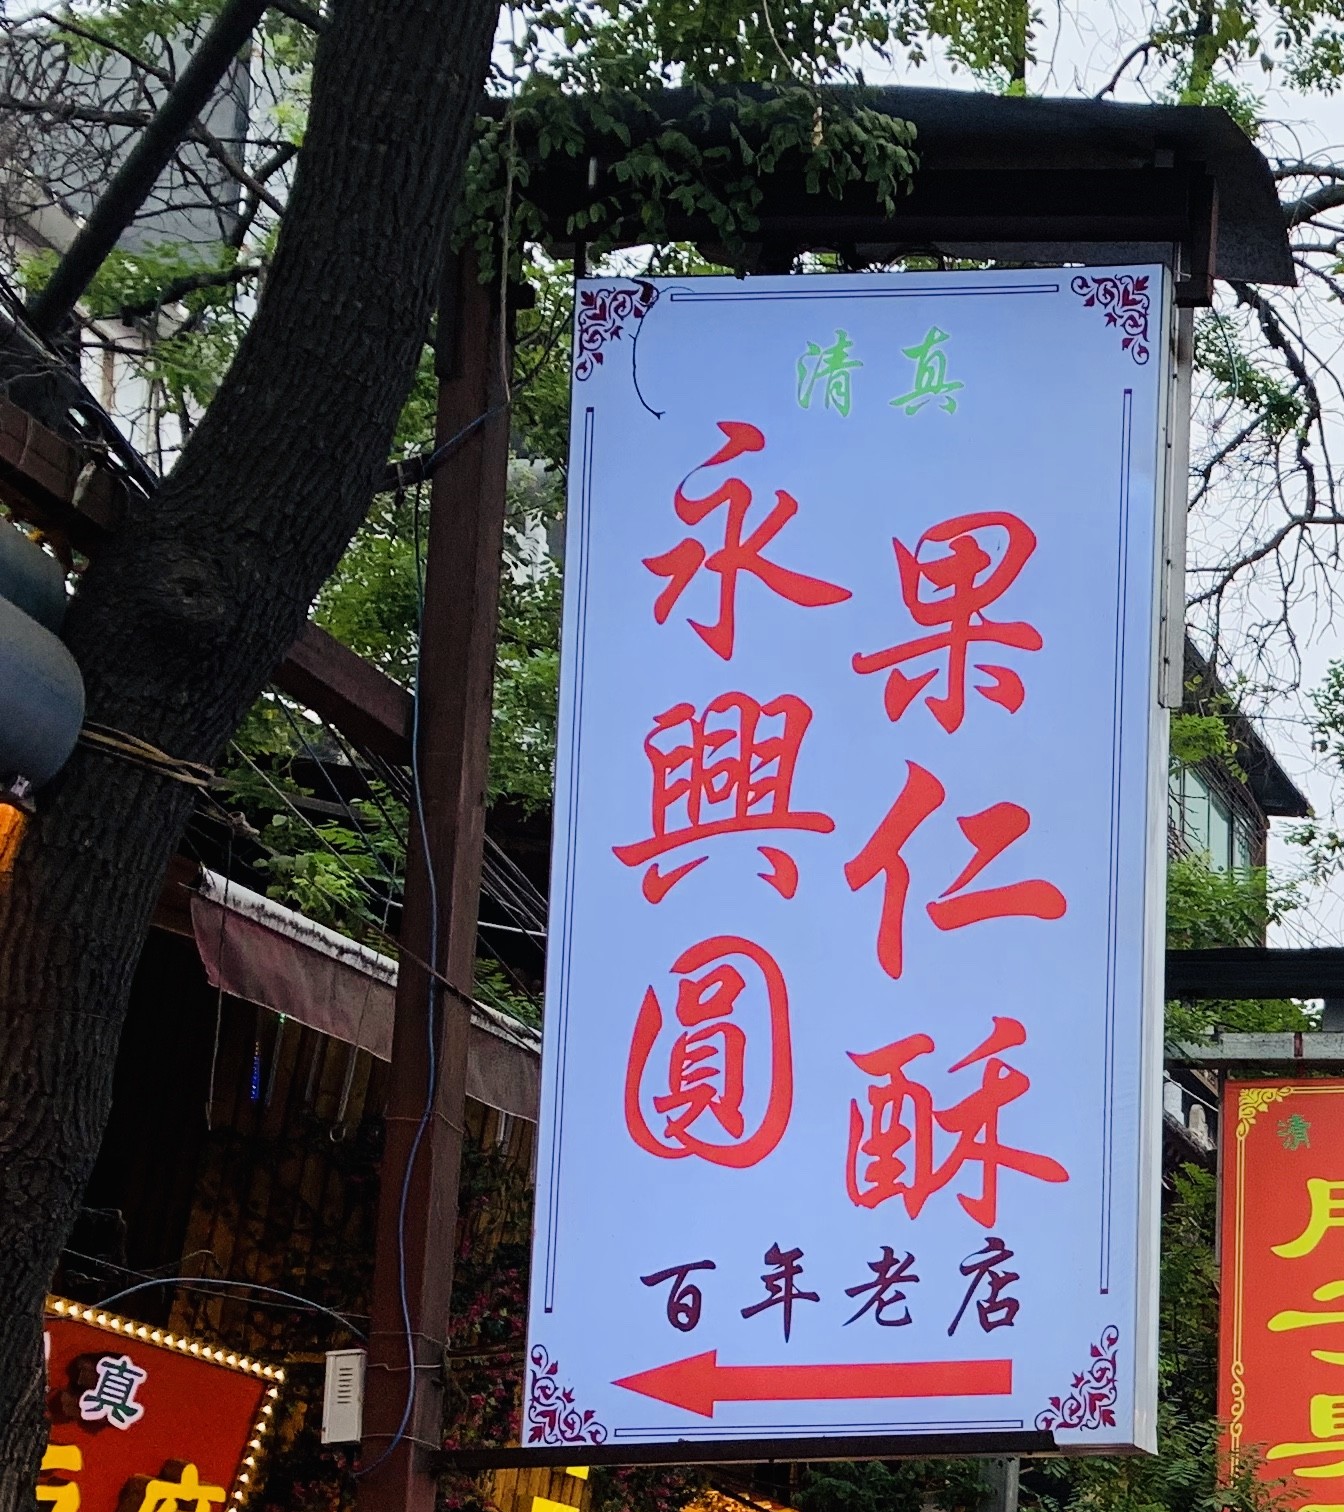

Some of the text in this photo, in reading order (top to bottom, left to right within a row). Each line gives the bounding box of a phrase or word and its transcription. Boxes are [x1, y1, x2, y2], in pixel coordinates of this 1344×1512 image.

[796, 324, 968, 418] 清真
[843, 510, 1071, 1229] 果仁酥
[639, 1235, 1022, 1342] 百年老店
[79, 1354, 148, 1430] 真
